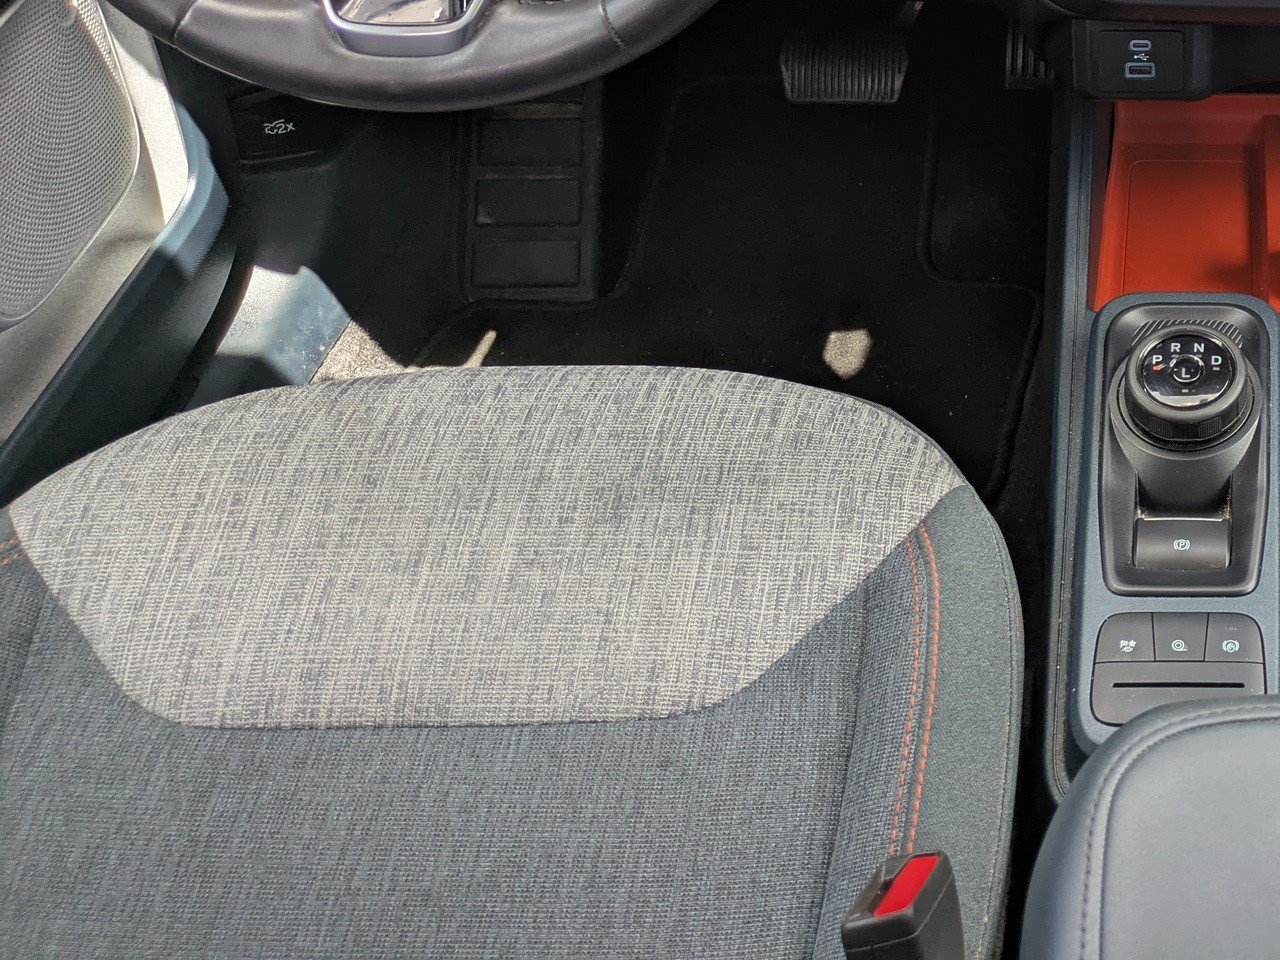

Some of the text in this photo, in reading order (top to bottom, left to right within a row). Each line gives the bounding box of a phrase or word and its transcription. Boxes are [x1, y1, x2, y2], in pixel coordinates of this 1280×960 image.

[1170, 342, 1205, 353] R N
[1152, 355, 1163, 365] P
[1211, 355, 1222, 365] D
[1181, 367, 1190, 378] L
